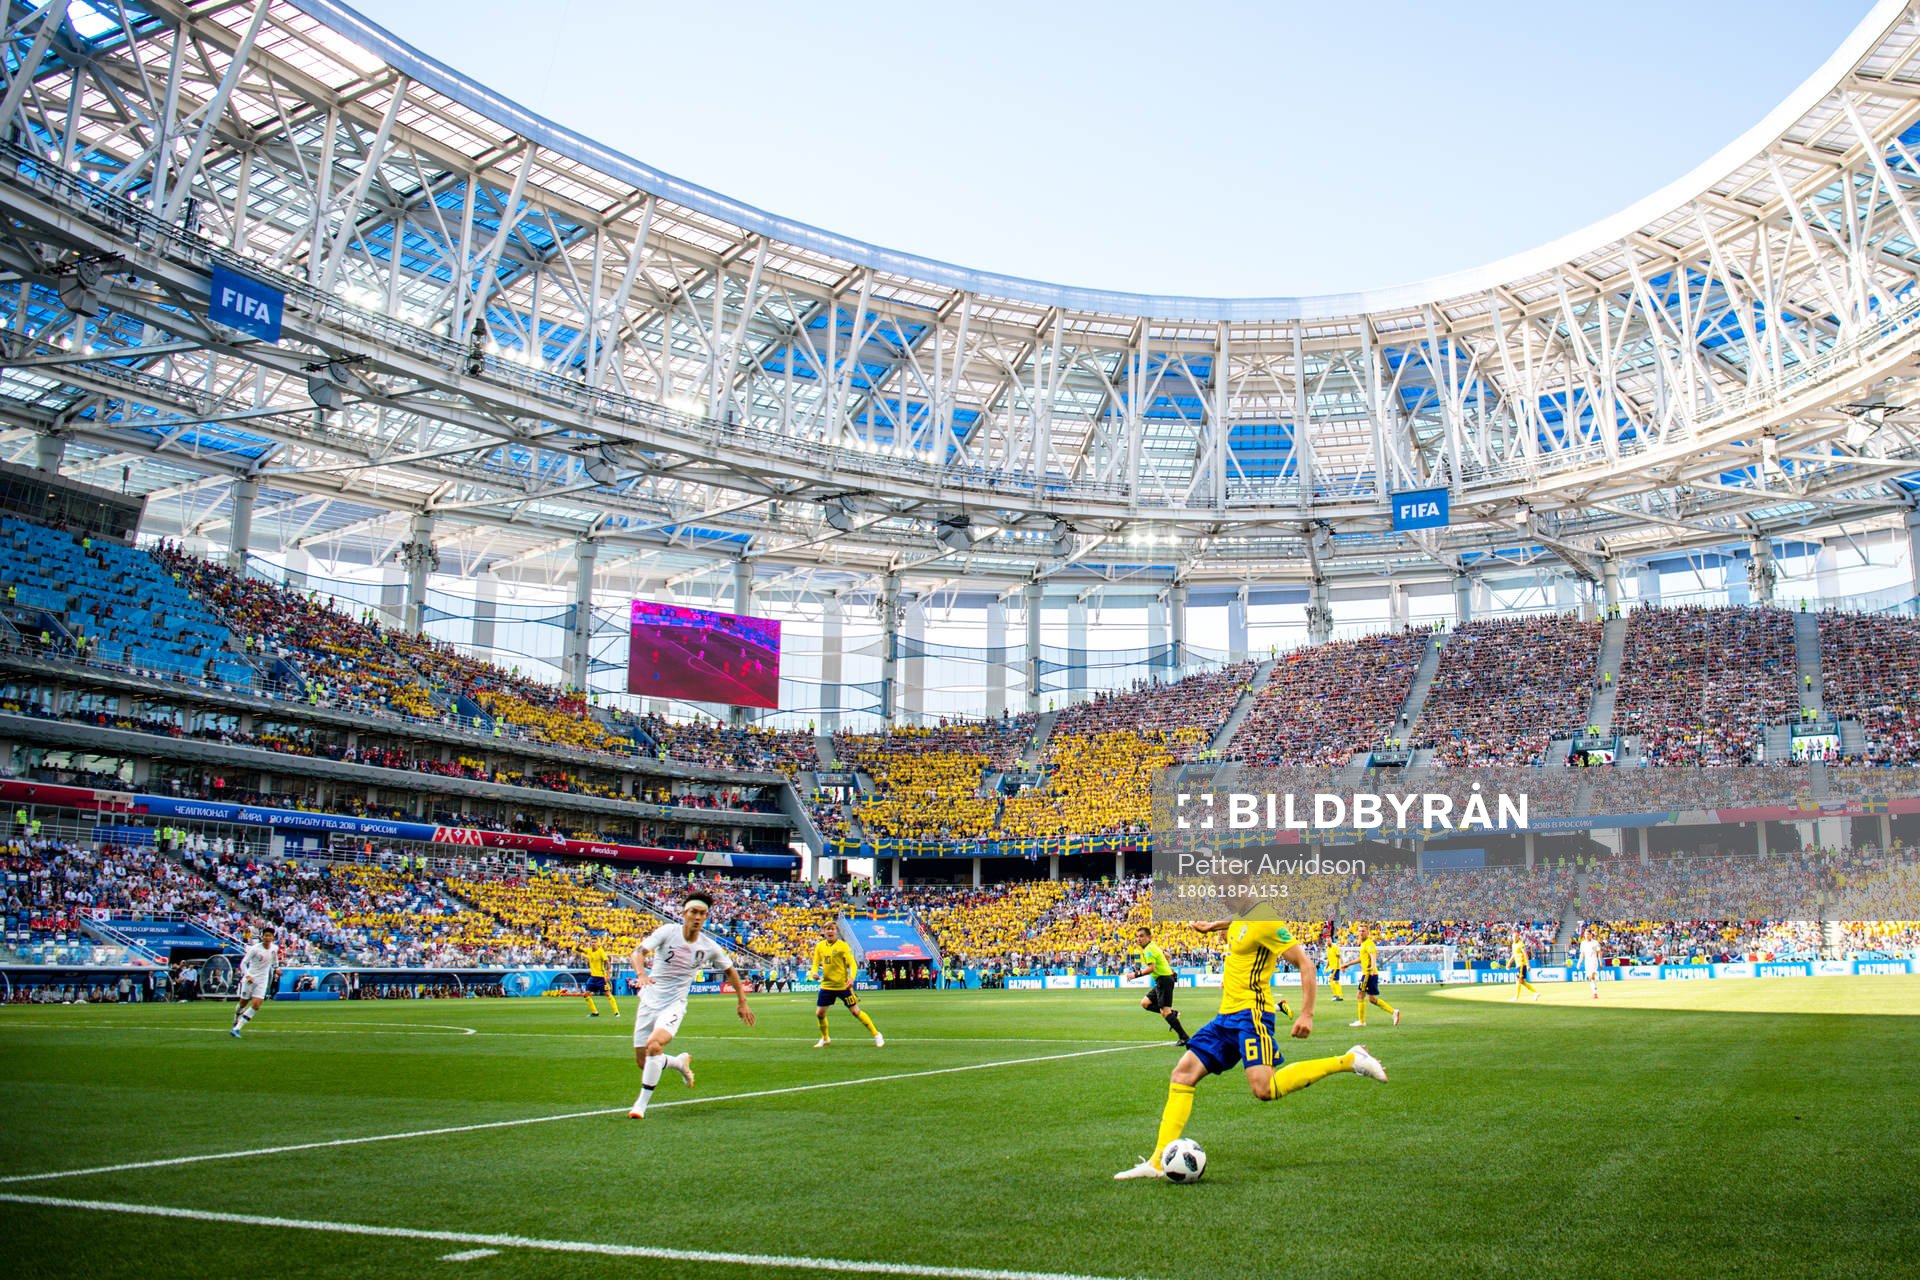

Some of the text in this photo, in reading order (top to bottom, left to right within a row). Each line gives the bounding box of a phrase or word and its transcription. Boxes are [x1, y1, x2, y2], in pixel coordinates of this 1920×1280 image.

[221, 286, 271, 325] FIFA
[1400, 502, 1440, 519] FIFA
[175, 805, 230, 819] ЧЕМПИОНАТ
[339, 821, 356, 830] 2018
[1532, 822, 1551, 830] 2018
[1559, 819, 1593, 828] РОССИИ
[590, 846, 618, 856] #worldcup
[664, 950, 676, 964] 2
[1665, 968, 1710, 981] GAZPROM
[1760, 965, 1807, 977] GAZPROM
[1859, 963, 1906, 976] GAZPROM
[1482, 972, 1518, 983] GAZPRO
[1572, 970, 1615, 982] GAZOM
[1008, 979, 1043, 989] GAZPROM
[1080, 978, 1116, 989] GAZPROM
[1245, 1038, 1259, 1061] 6
